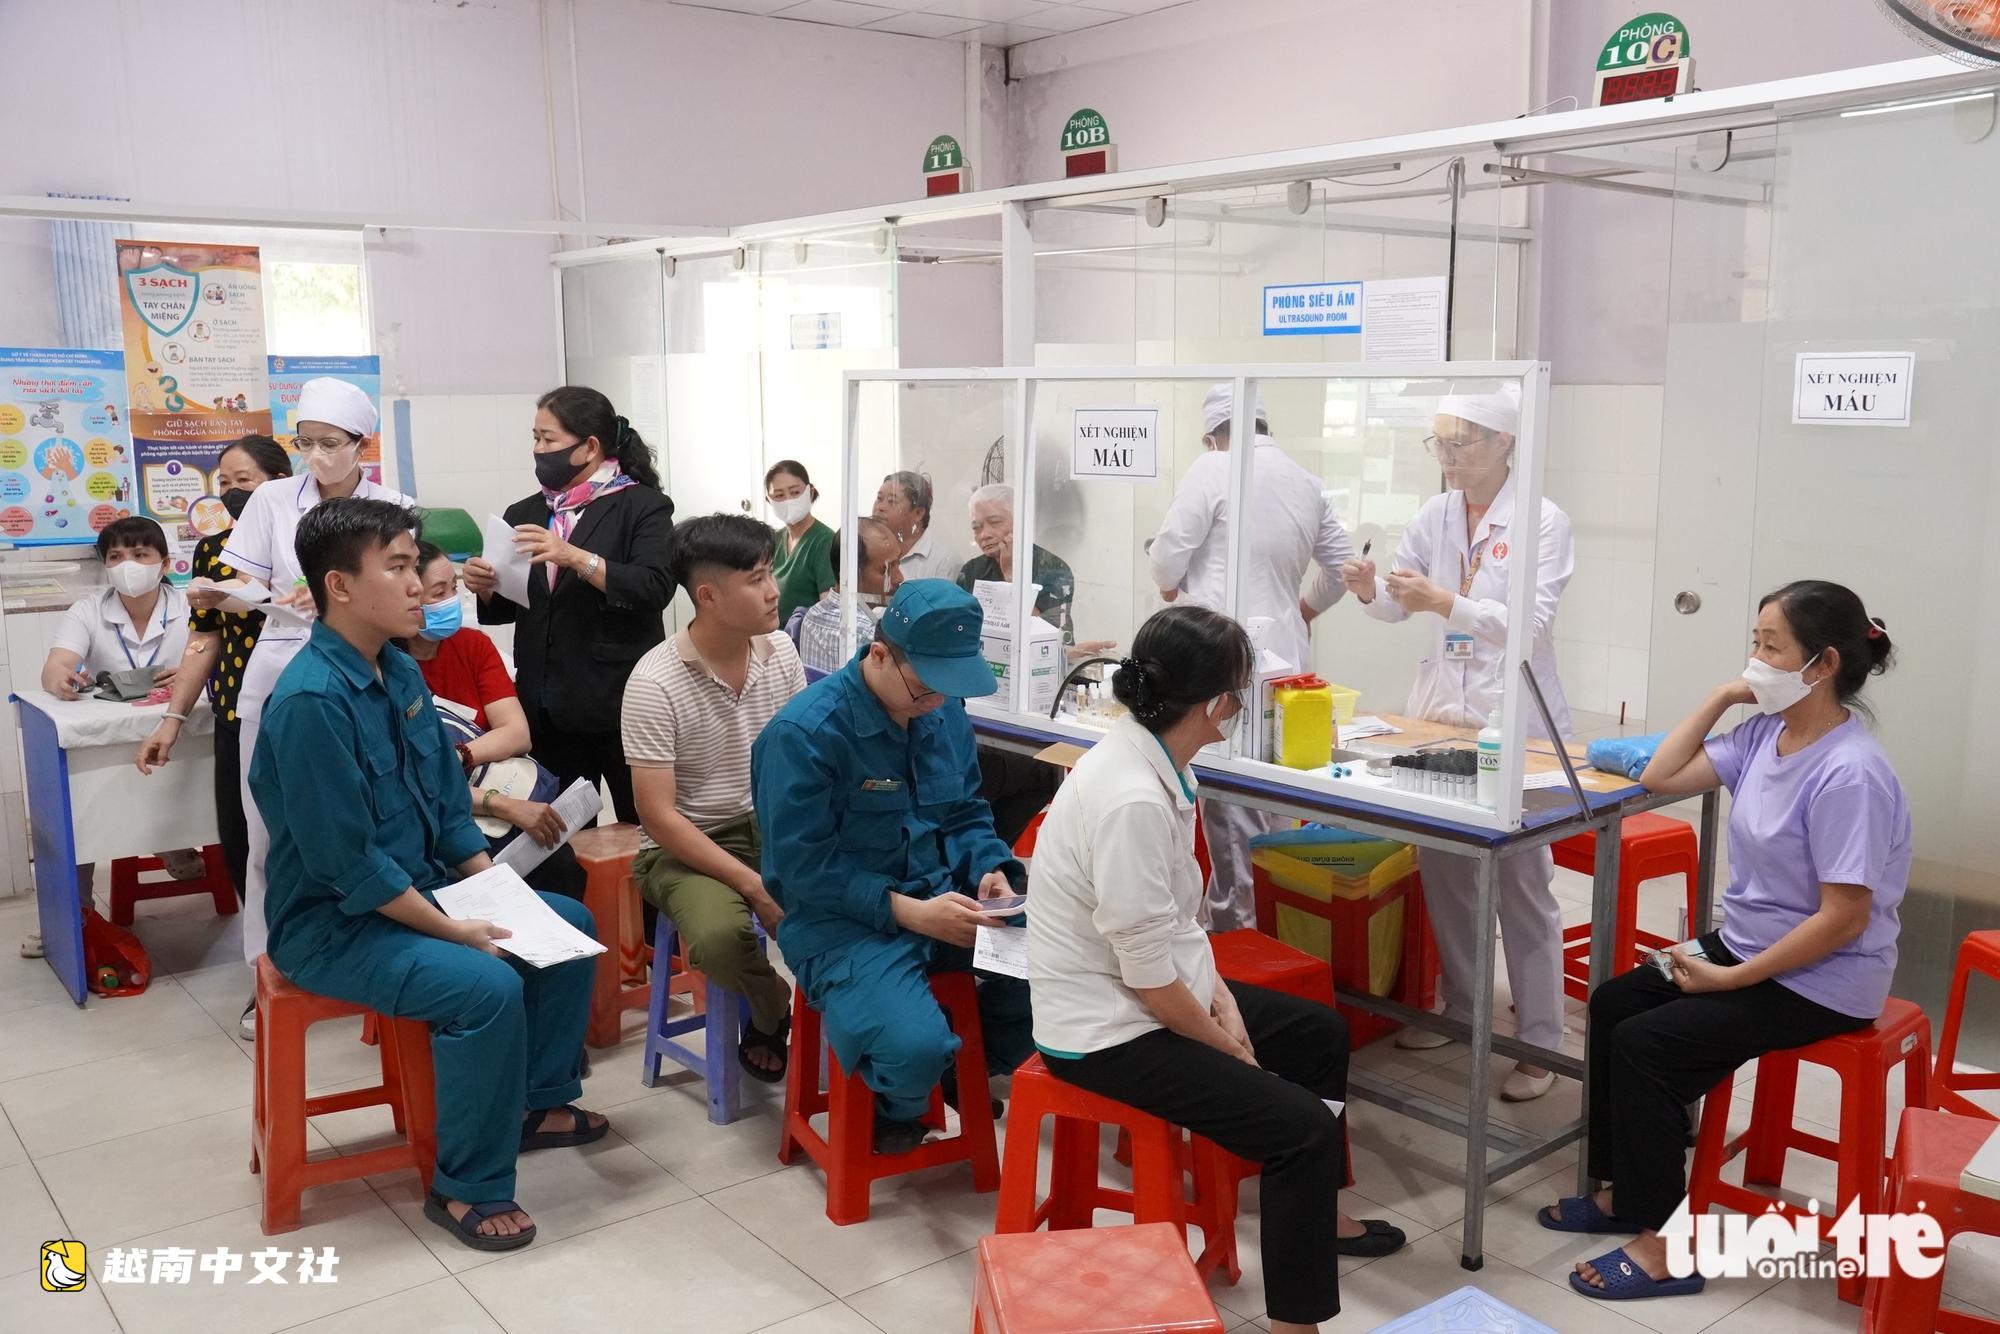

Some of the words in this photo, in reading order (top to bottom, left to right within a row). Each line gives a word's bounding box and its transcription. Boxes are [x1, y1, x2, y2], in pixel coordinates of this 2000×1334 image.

[1619, 21, 1674, 42] PHÒNG
[1604, 34, 1677, 66] 10C
[1070, 115, 1099, 129] PHÒNG
[1064, 126, 1105, 147] 10B
[931, 141, 955, 154] PHÒNG
[931, 152, 955, 169] 11
[139, 278, 146, 287] 3
[150, 278, 187, 289] SẠCH
[143, 301, 159, 309] TAY
[1272, 292, 1305, 309] PHÒNG
[1309, 291, 1333, 308] SIÊU
[1337, 290, 1355, 306] ÂM
[1278, 313, 1324, 324] ULTRASOUND
[1326, 312, 1348, 322] ROOM
[1807, 370, 1834, 384] XÉT
[1839, 371, 1897, 387] NGHIỆM
[1823, 389, 1877, 412] MÁU
[153, 428, 182, 436] PHÒNG
[1080, 423, 1100, 438] XÉT
[1103, 425, 1148, 442] NGHIỆM
[1093, 443, 1134, 468] MÁU
